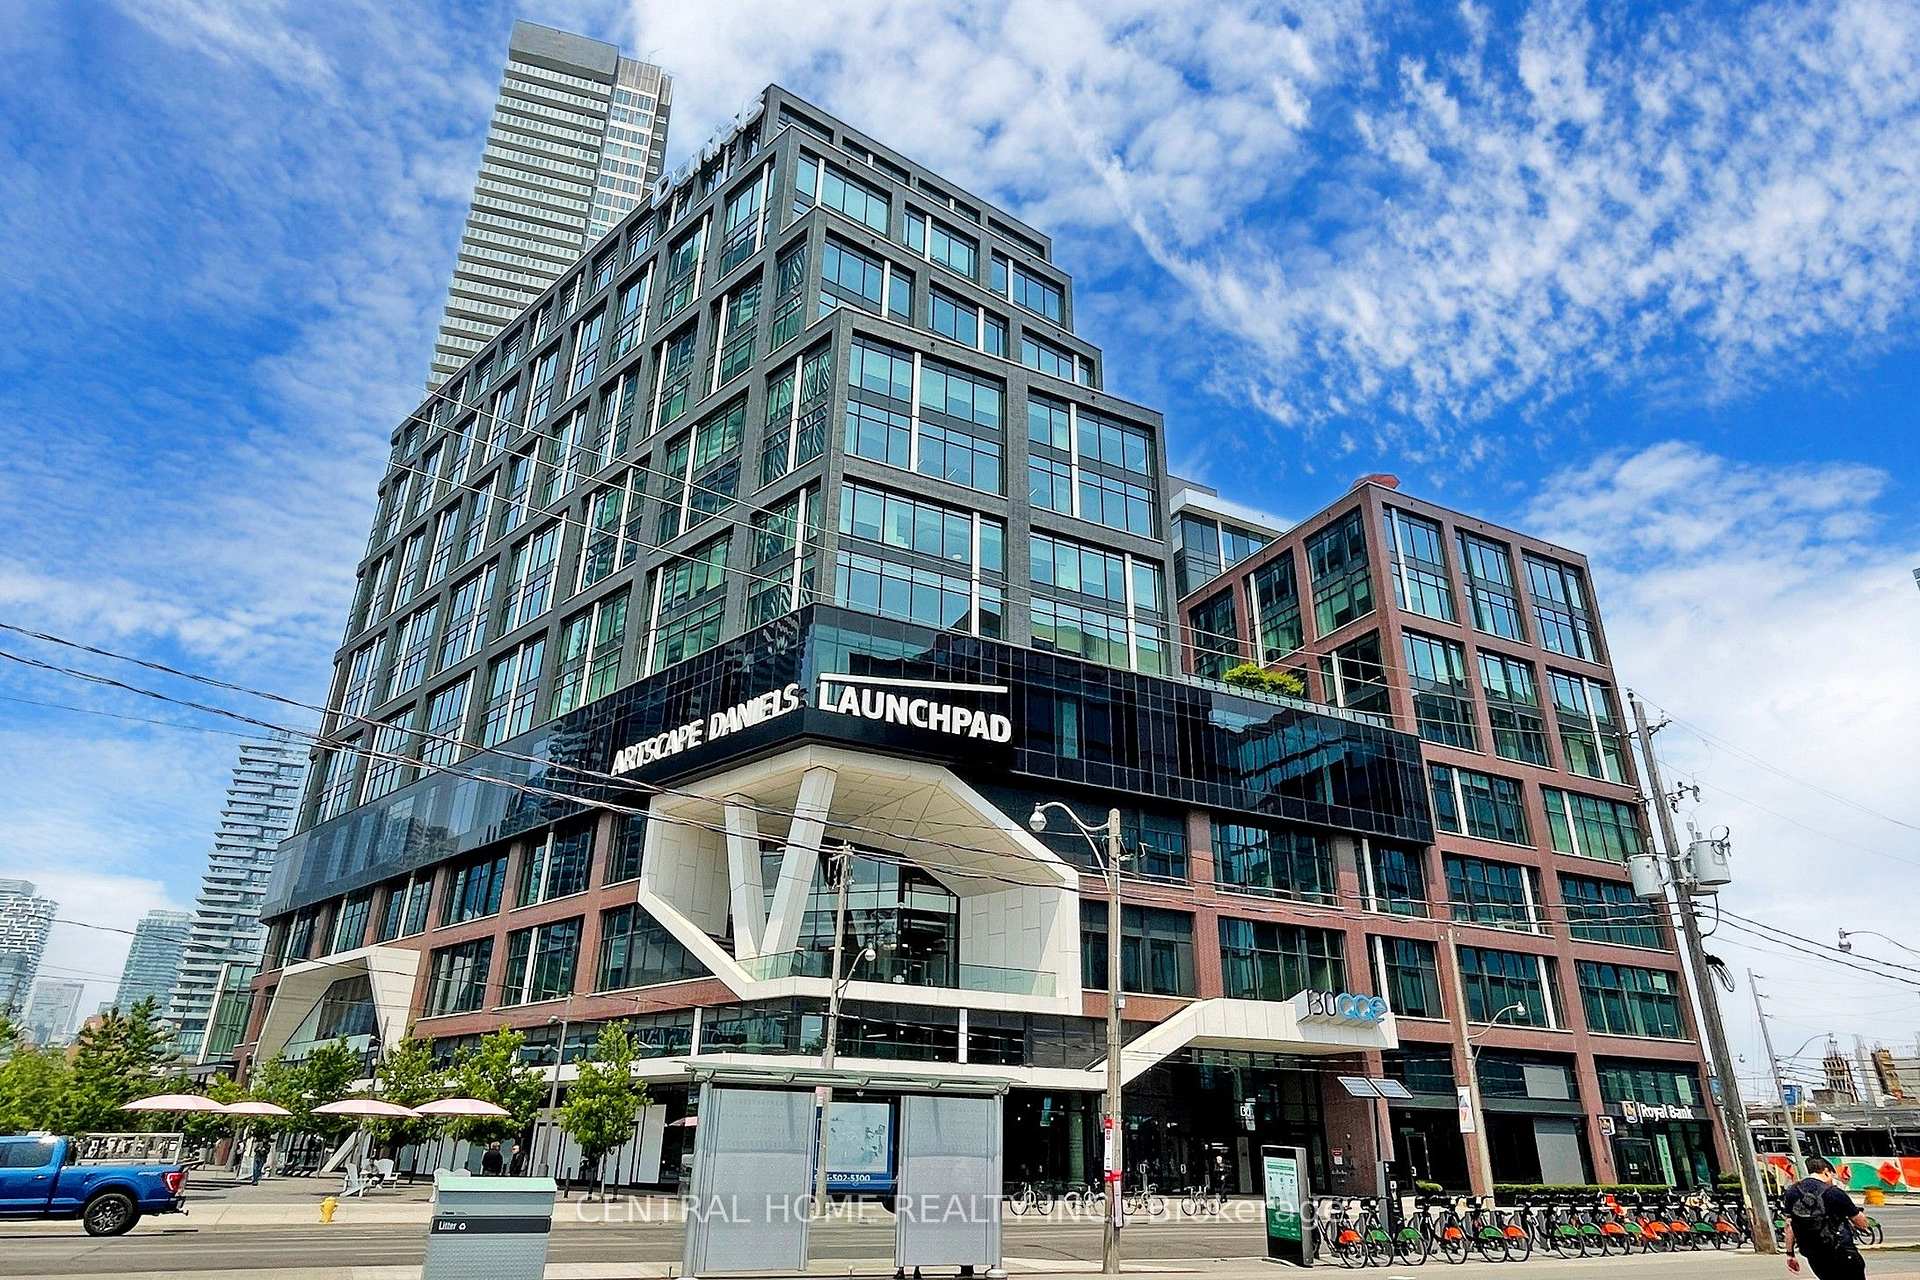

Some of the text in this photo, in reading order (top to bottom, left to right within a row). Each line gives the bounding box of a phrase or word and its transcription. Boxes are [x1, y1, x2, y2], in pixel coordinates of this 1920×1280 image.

[610, 682, 799, 777] ARTSCAPE DANIELS
[818, 681, 1012, 743] LAUNCHPAD
[1640, 1103, 1695, 1122] Royal Bank
[438, 1221, 457, 1231] Litter
